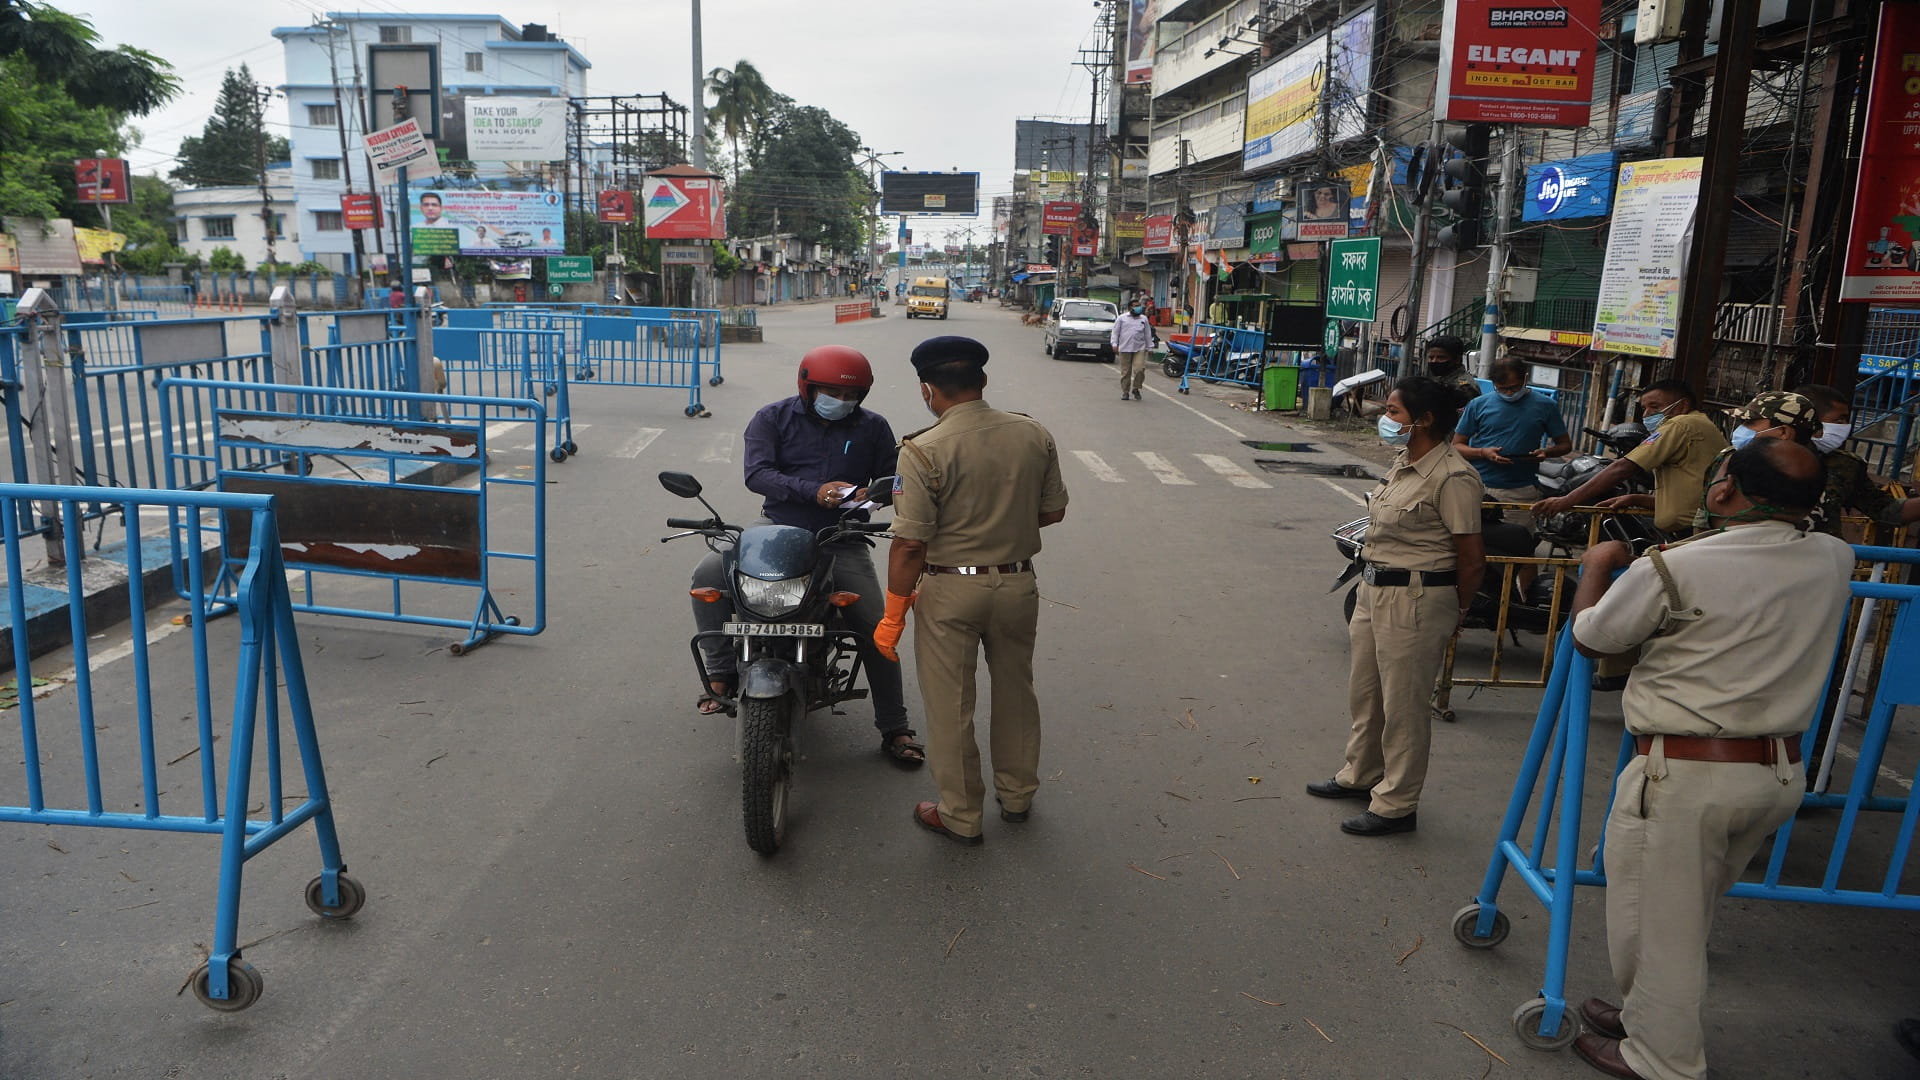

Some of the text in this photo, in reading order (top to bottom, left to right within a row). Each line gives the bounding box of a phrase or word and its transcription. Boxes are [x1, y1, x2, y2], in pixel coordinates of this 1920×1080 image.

[1491, 10, 1565, 21] BHAROSA
[1468, 45, 1581, 66] ELEGANT
[1471, 74, 1508, 83] INDIA'S
[474, 107, 518, 116] TAKE YOUR
[474, 118, 543, 128] IDEA TO STARTUP
[1538, 178, 1558, 200] Jio
[1563, 188, 1579, 198] LIFE
[1342, 252, 1368, 270] সফদর
[1332, 280, 1356, 307] হাসমি
